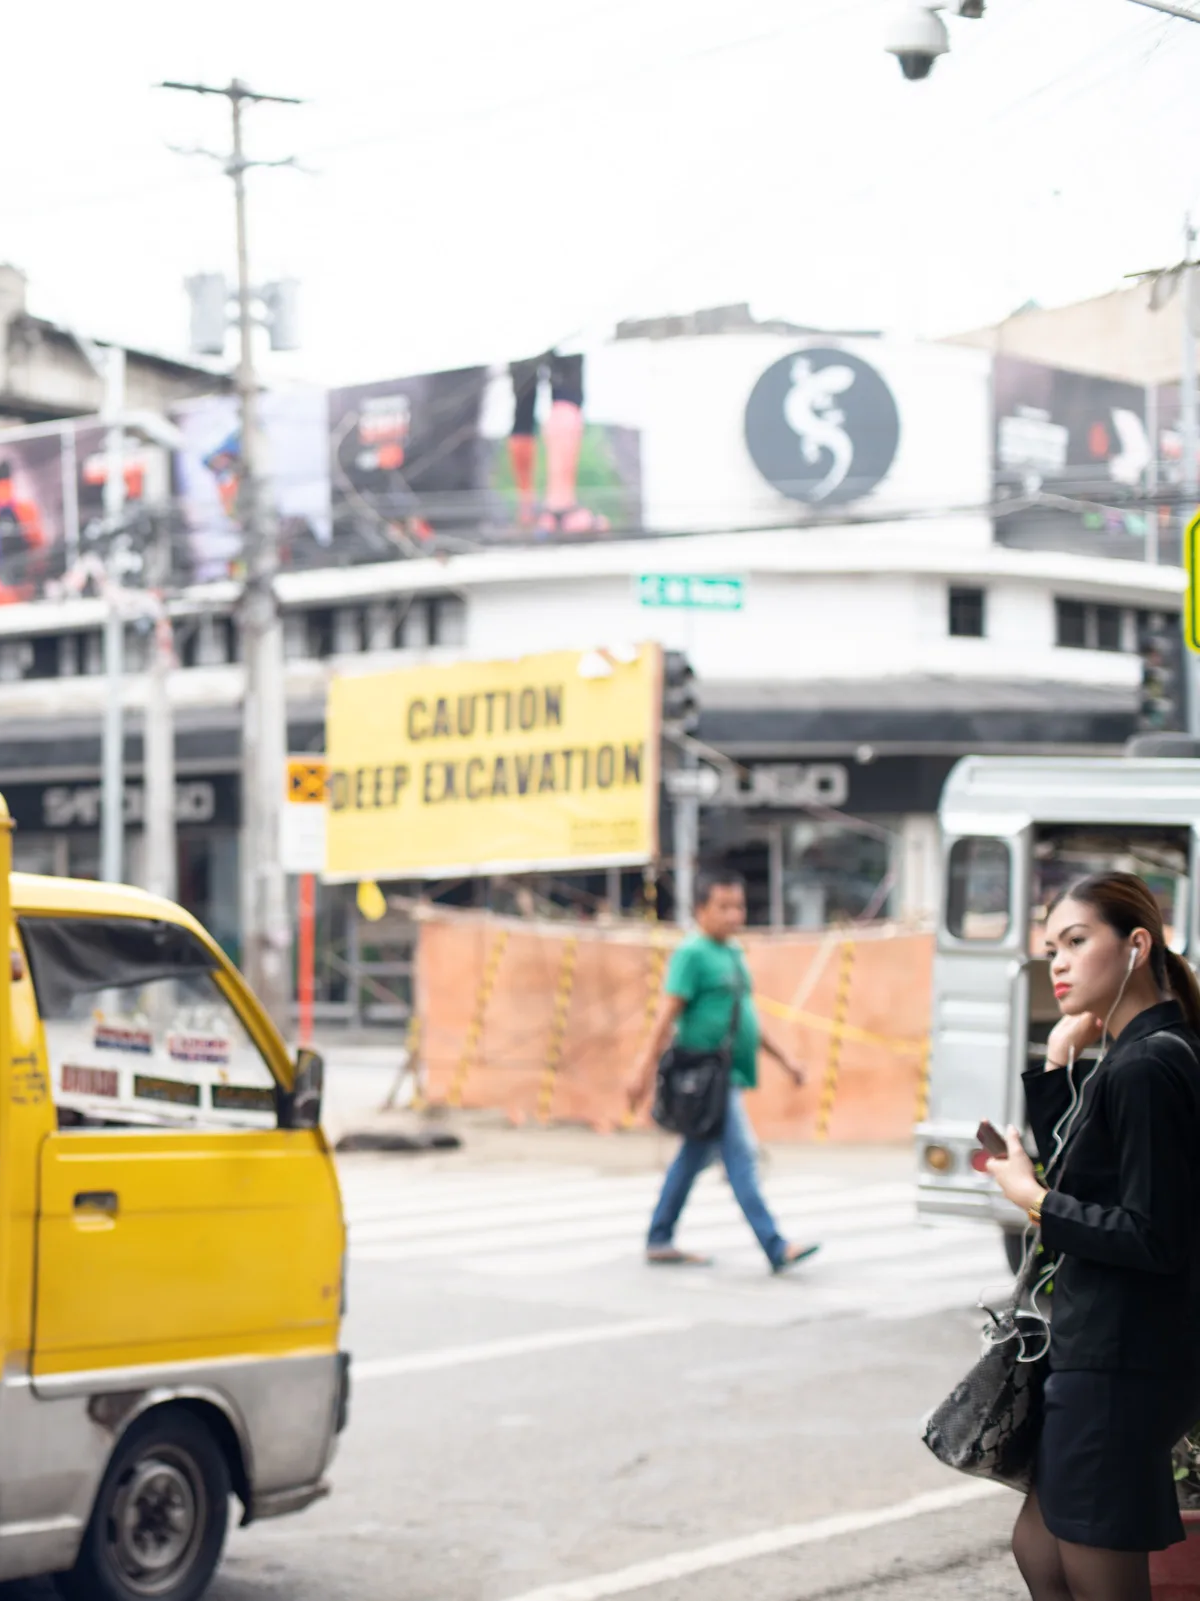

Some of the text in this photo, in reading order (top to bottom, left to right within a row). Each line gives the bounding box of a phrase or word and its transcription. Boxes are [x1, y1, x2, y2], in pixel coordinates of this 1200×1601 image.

[406, 683, 565, 742] CAUTION
[331, 742, 645, 812] DEEP EXCAVATION
